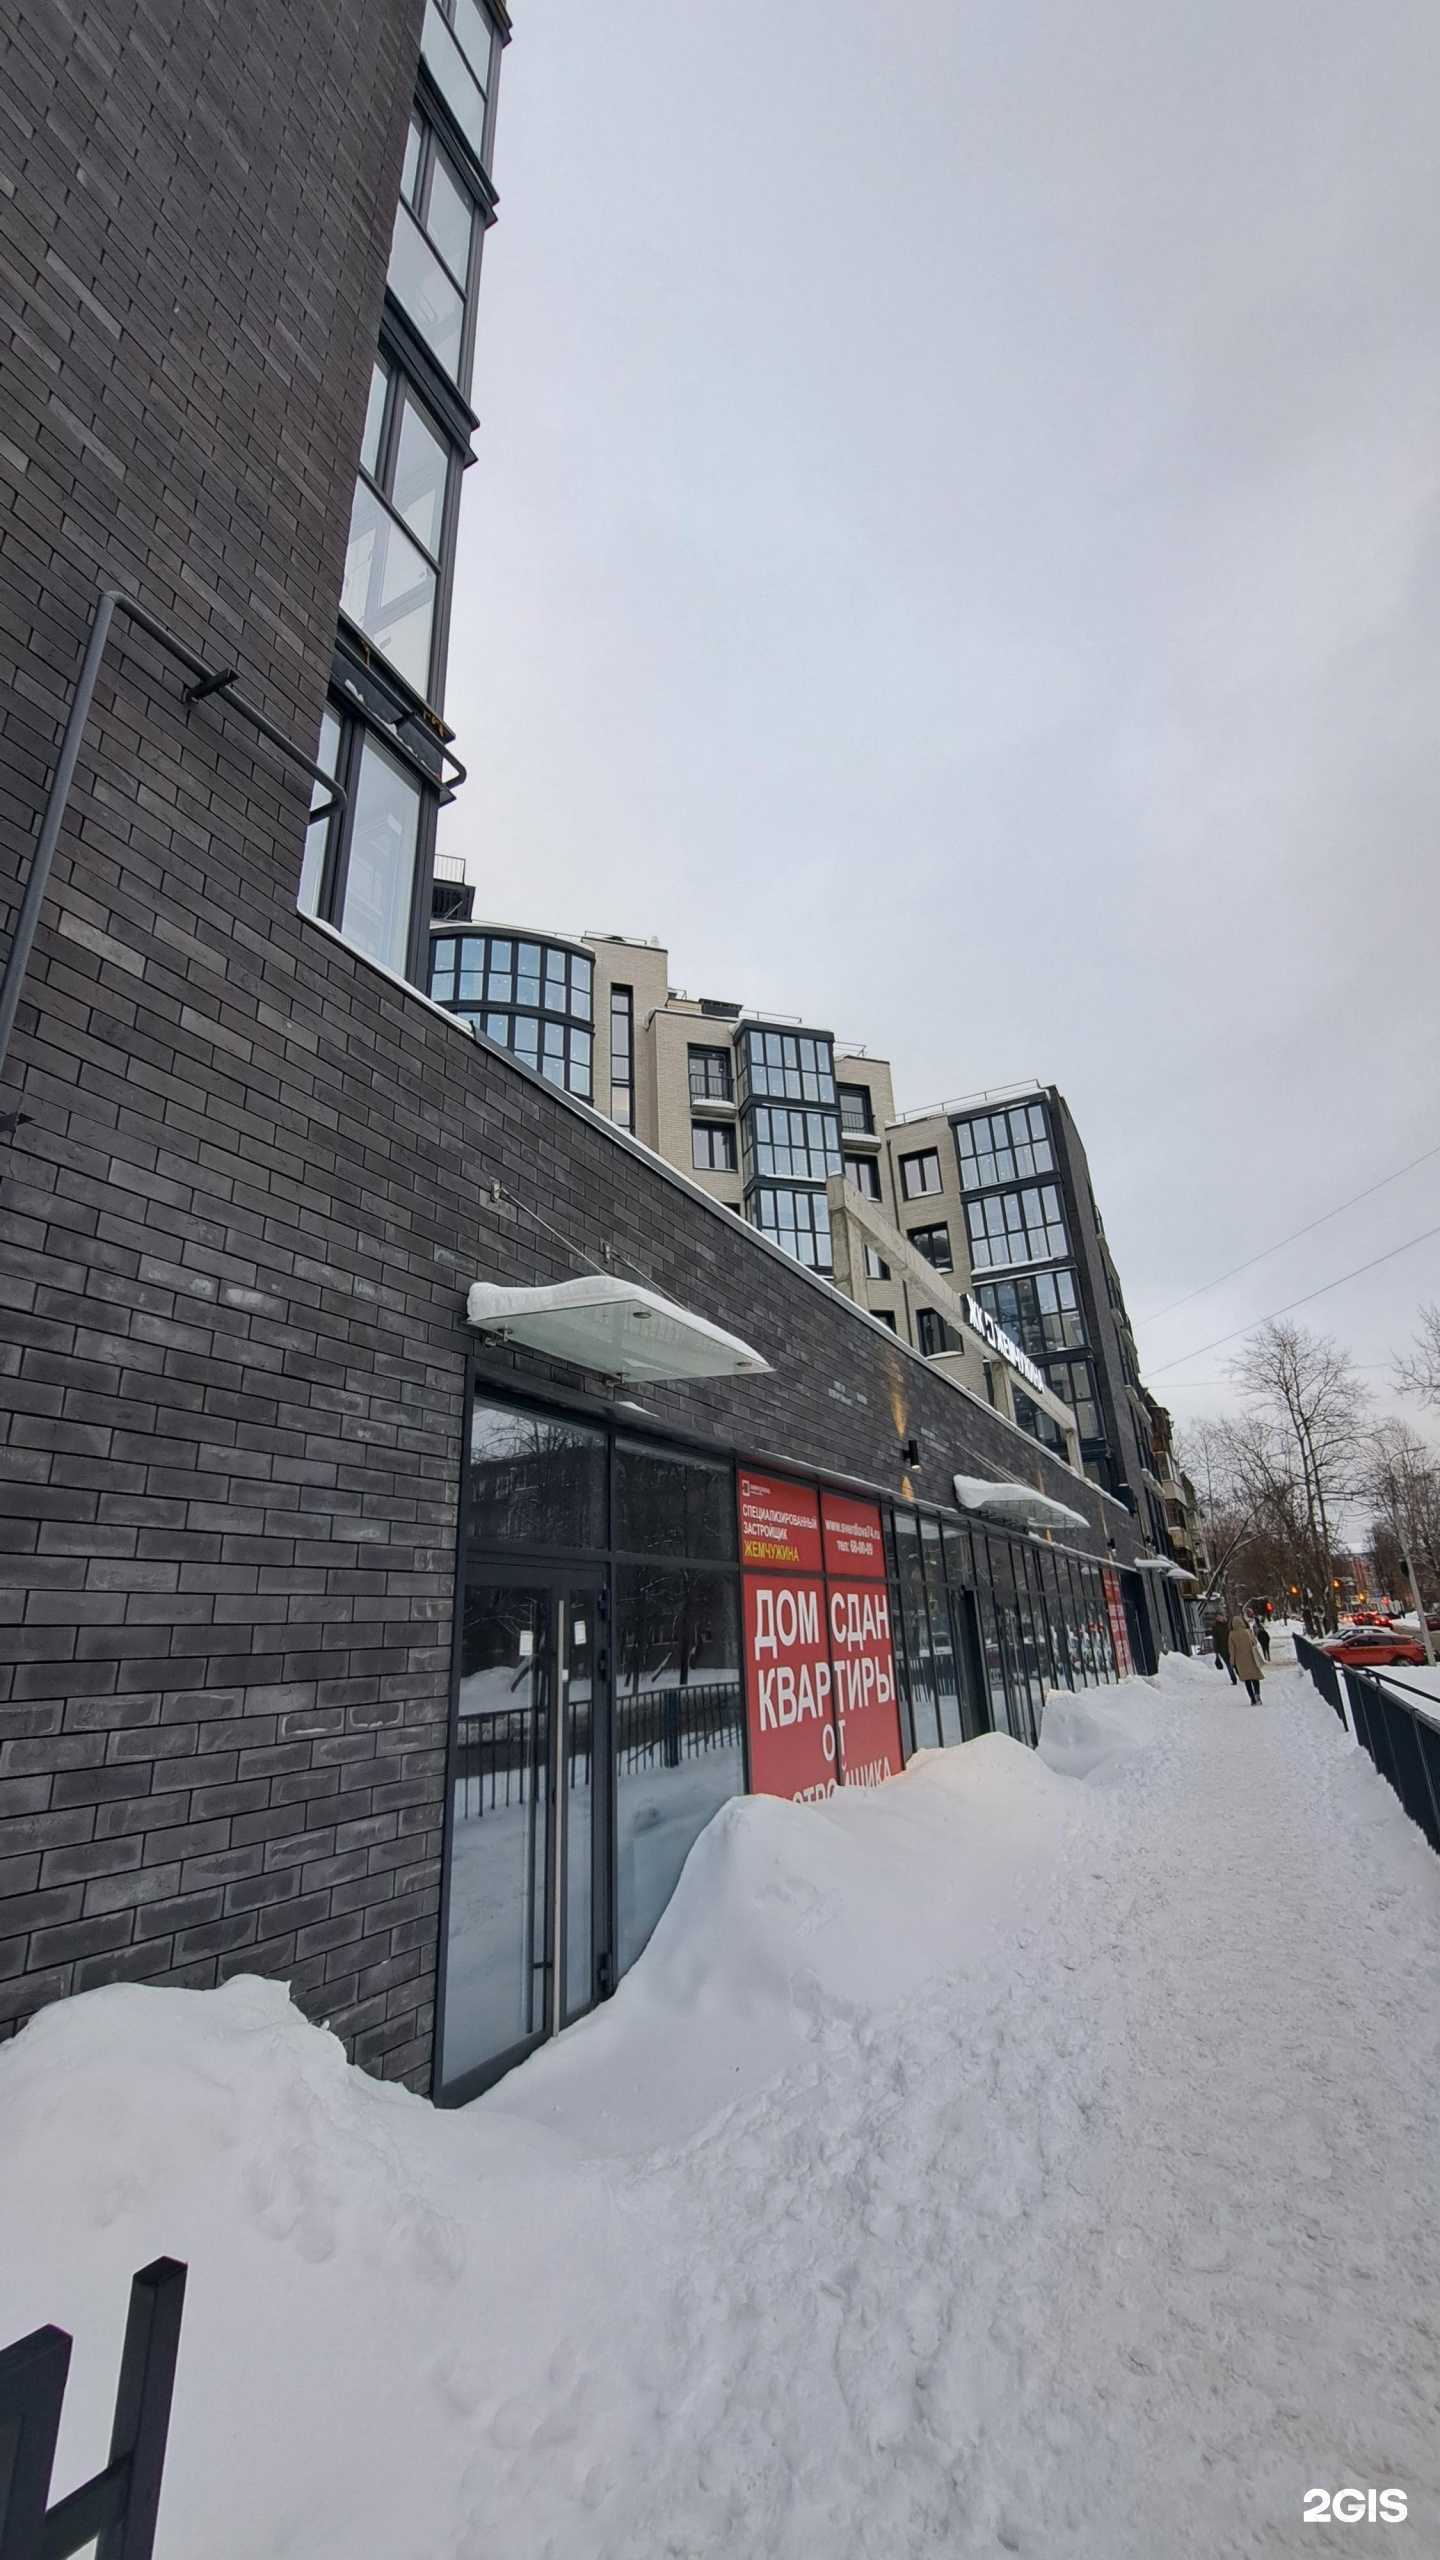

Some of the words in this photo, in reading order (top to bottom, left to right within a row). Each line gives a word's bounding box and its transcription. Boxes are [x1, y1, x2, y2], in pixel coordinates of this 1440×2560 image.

[743, 1522, 788, 1541] ЗАСТРОЙЩИК
[744, 1540, 800, 1562] ЖЕМЧУЖИНА
[754, 1589, 820, 1661] ДОМ
[831, 1592, 890, 1652] СДАН
[758, 1654, 896, 1732] КВАРТИРЫ
[822, 1719, 846, 1762] ОТ
